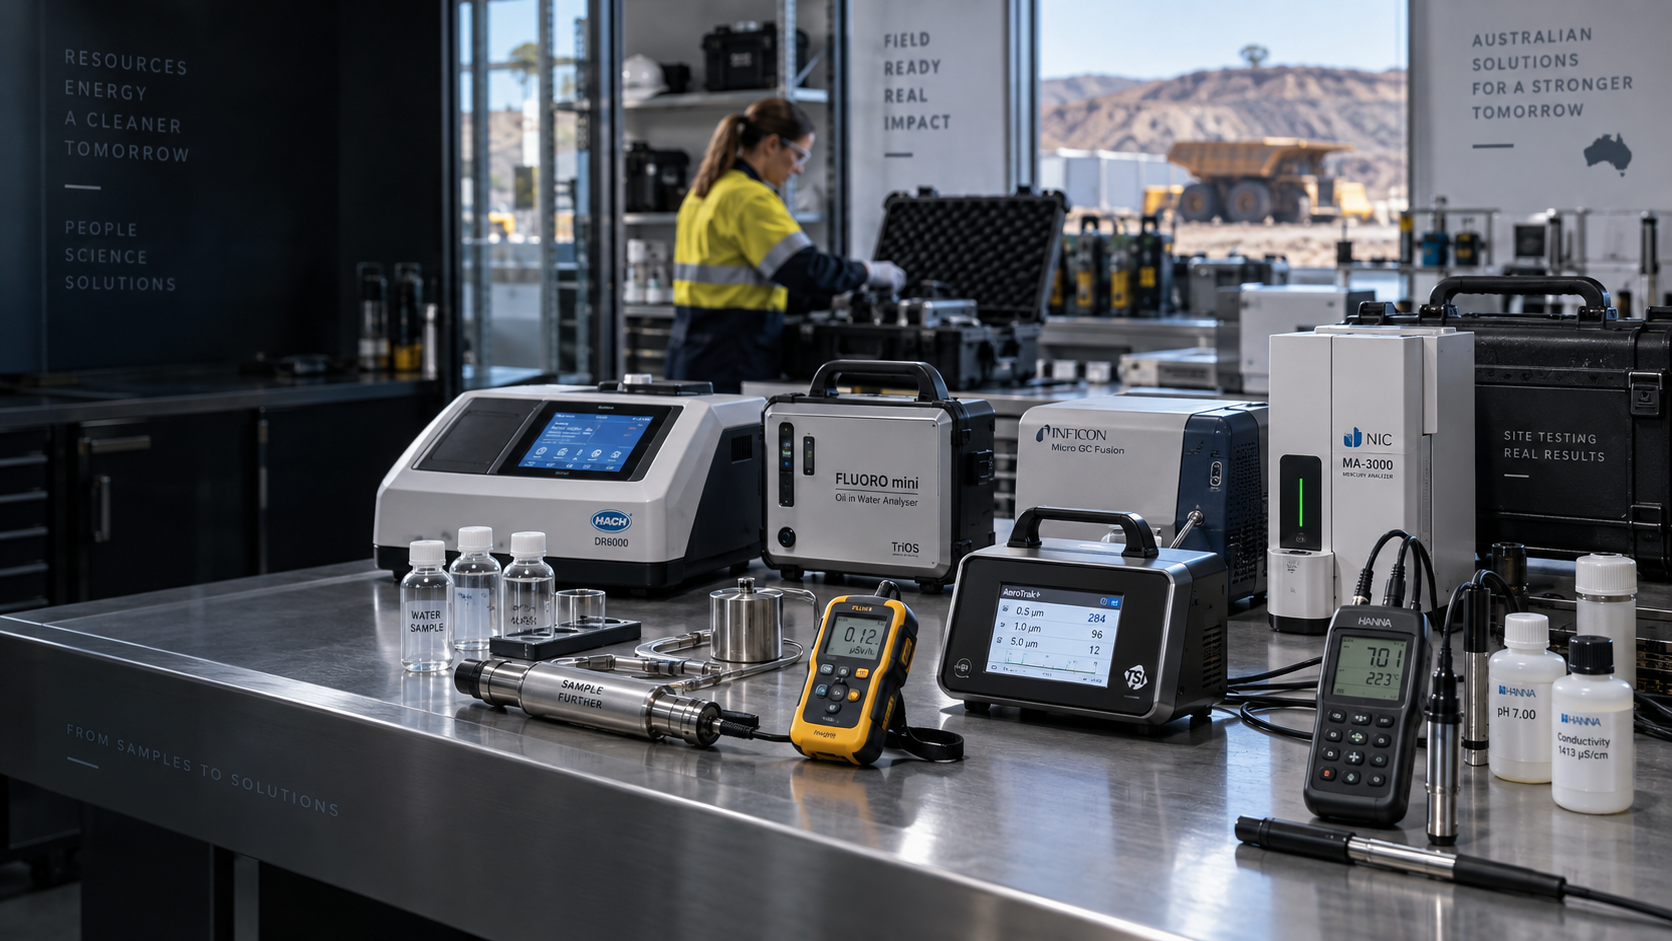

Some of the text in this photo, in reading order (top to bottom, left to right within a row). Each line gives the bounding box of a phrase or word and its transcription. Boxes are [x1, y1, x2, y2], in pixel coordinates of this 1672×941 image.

[884, 31, 931, 48] FIELD
[1472, 27, 1592, 47] AUSTRALIAN
[64, 48, 188, 76] RESOURCES
[884, 59, 941, 76] READY
[1472, 53, 1579, 72] SOLUTIONS
[64, 79, 147, 101] ENERGY
[1472, 76, 1633, 96] FOR A STRONGER
[884, 87, 928, 103] REAL
[1472, 103, 1584, 120] TOMORROW
[64, 110, 182, 134] A CLEANER
[884, 114, 951, 131] IMPACT
[64, 139, 190, 163] TOMORROW
[64, 220, 138, 237] PEOPLE
[64, 247, 148, 265] SCIENCE
[64, 275, 177, 292] SOLUTIONS
[1051, 427, 1107, 441] INFICON
[1366, 432, 1393, 446] NIC
[1504, 430, 1597, 444] SITE TESTING
[1051, 443, 1125, 455] Micro GC Fusion
[1504, 447, 1605, 462] REAL RESULTS
[1342, 457, 1394, 471] MA-3000
[835, 472, 919, 490] FLUORO mini
[835, 493, 919, 508] Oil in Water Analyser
[594, 516, 628, 526] HACH
[594, 536, 629, 548] DR6000
[891, 541, 920, 554] TriOS
[411, 610, 441, 620] WATER
[1016, 606, 1106, 623] 0.5 µm 284
[1358, 616, 1392, 628] HANNA
[410, 622, 444, 633] SAMPLE
[844, 626, 877, 645] 0.12
[1014, 621, 1103, 639] 1.0 µm 96
[1010, 636, 1101, 655] 5.0 µm 12
[1127, 670, 1146, 685] TSI
[561, 679, 604, 695] SAMPLE
[1506, 686, 1537, 698] HANNA
[557, 692, 603, 709] FURTHER
[1497, 706, 1537, 720] pH 7.00
[1568, 715, 1602, 727] HANNA
[1557, 732, 1611, 748] Conductivity
[1558, 745, 1609, 761] 1413 µS/cm
[67, 723, 339, 818] FROM SAMPLES TO SOLUTIONS
